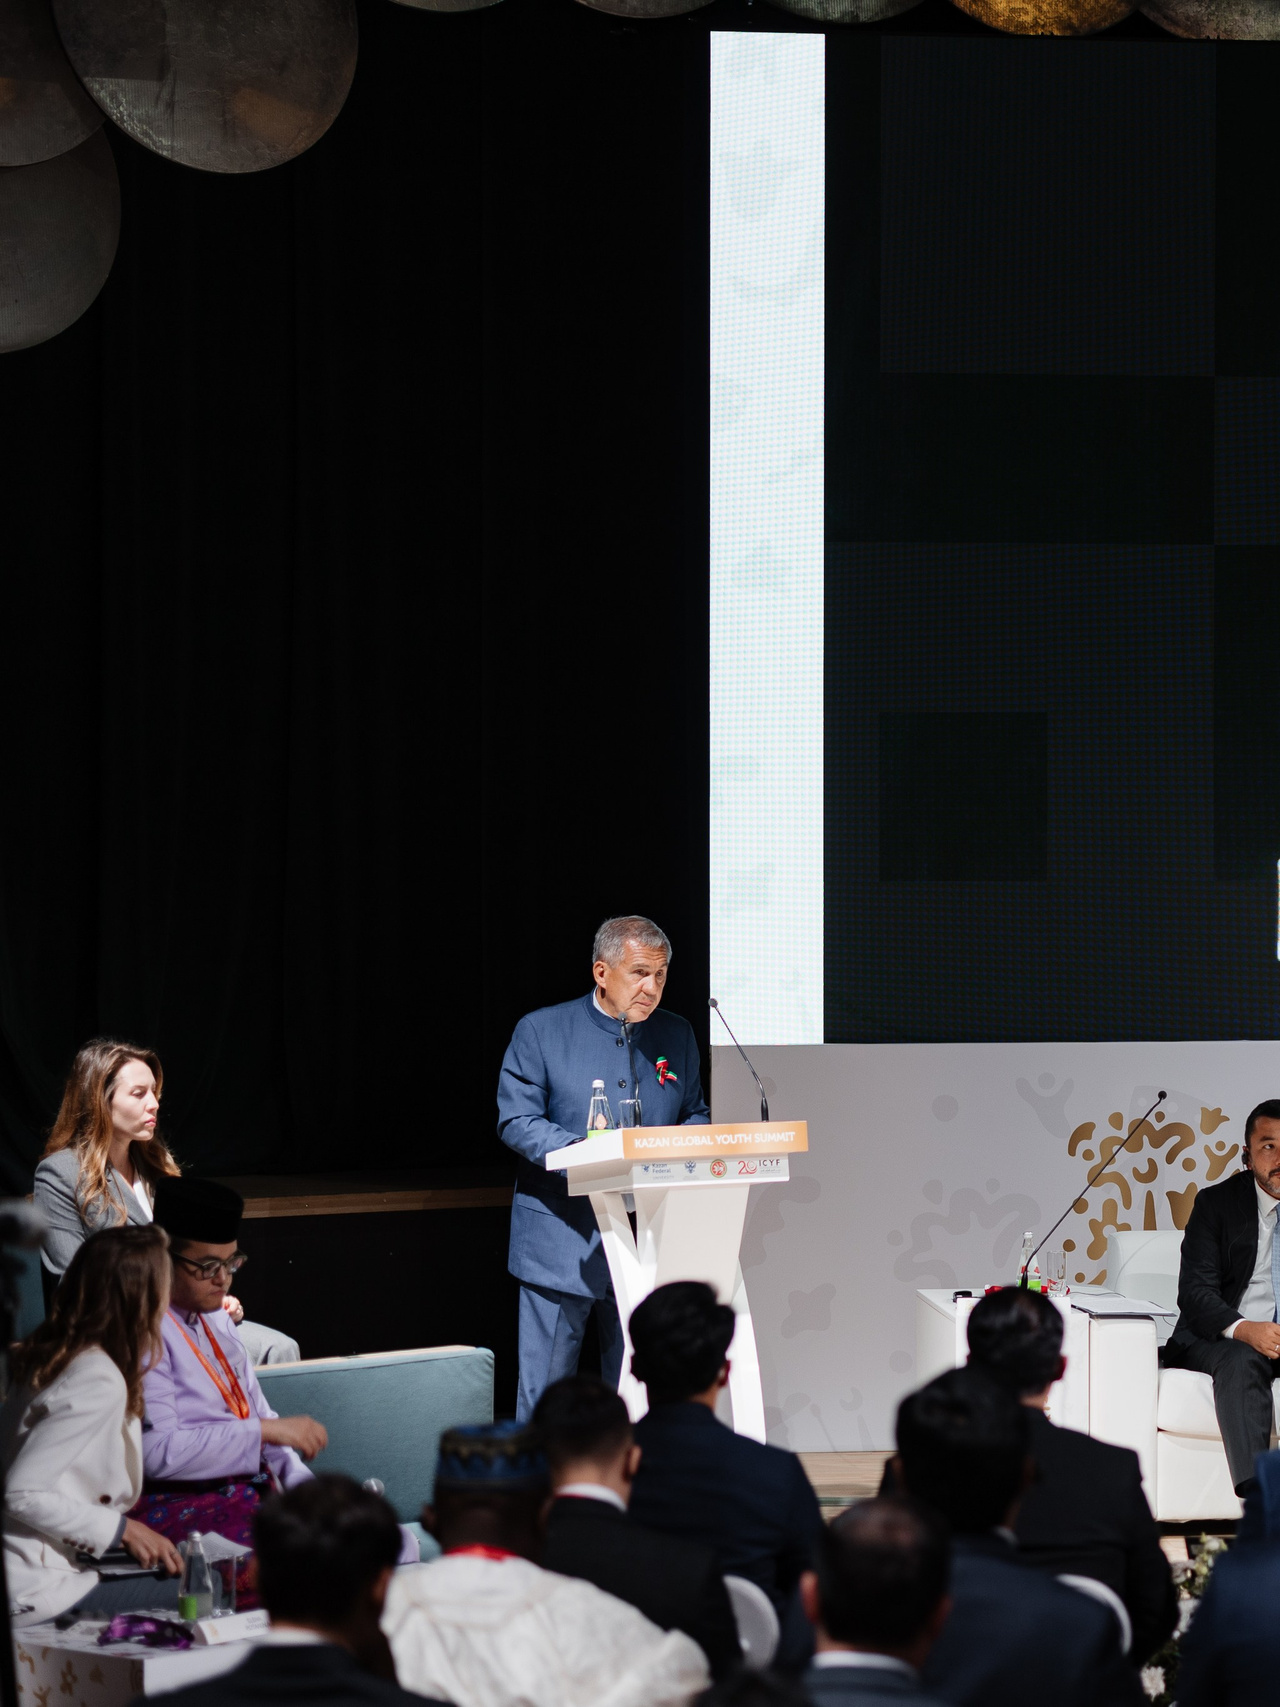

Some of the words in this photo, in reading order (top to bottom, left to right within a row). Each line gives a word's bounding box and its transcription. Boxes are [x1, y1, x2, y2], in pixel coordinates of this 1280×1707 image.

[634, 1137, 670, 1149] KAZAN
[672, 1135, 714, 1147] GLOBAL
[715, 1133, 752, 1145] YOUTH
[754, 1131, 796, 1143] SUMMIT
[759, 1159, 781, 1167] ICYF
